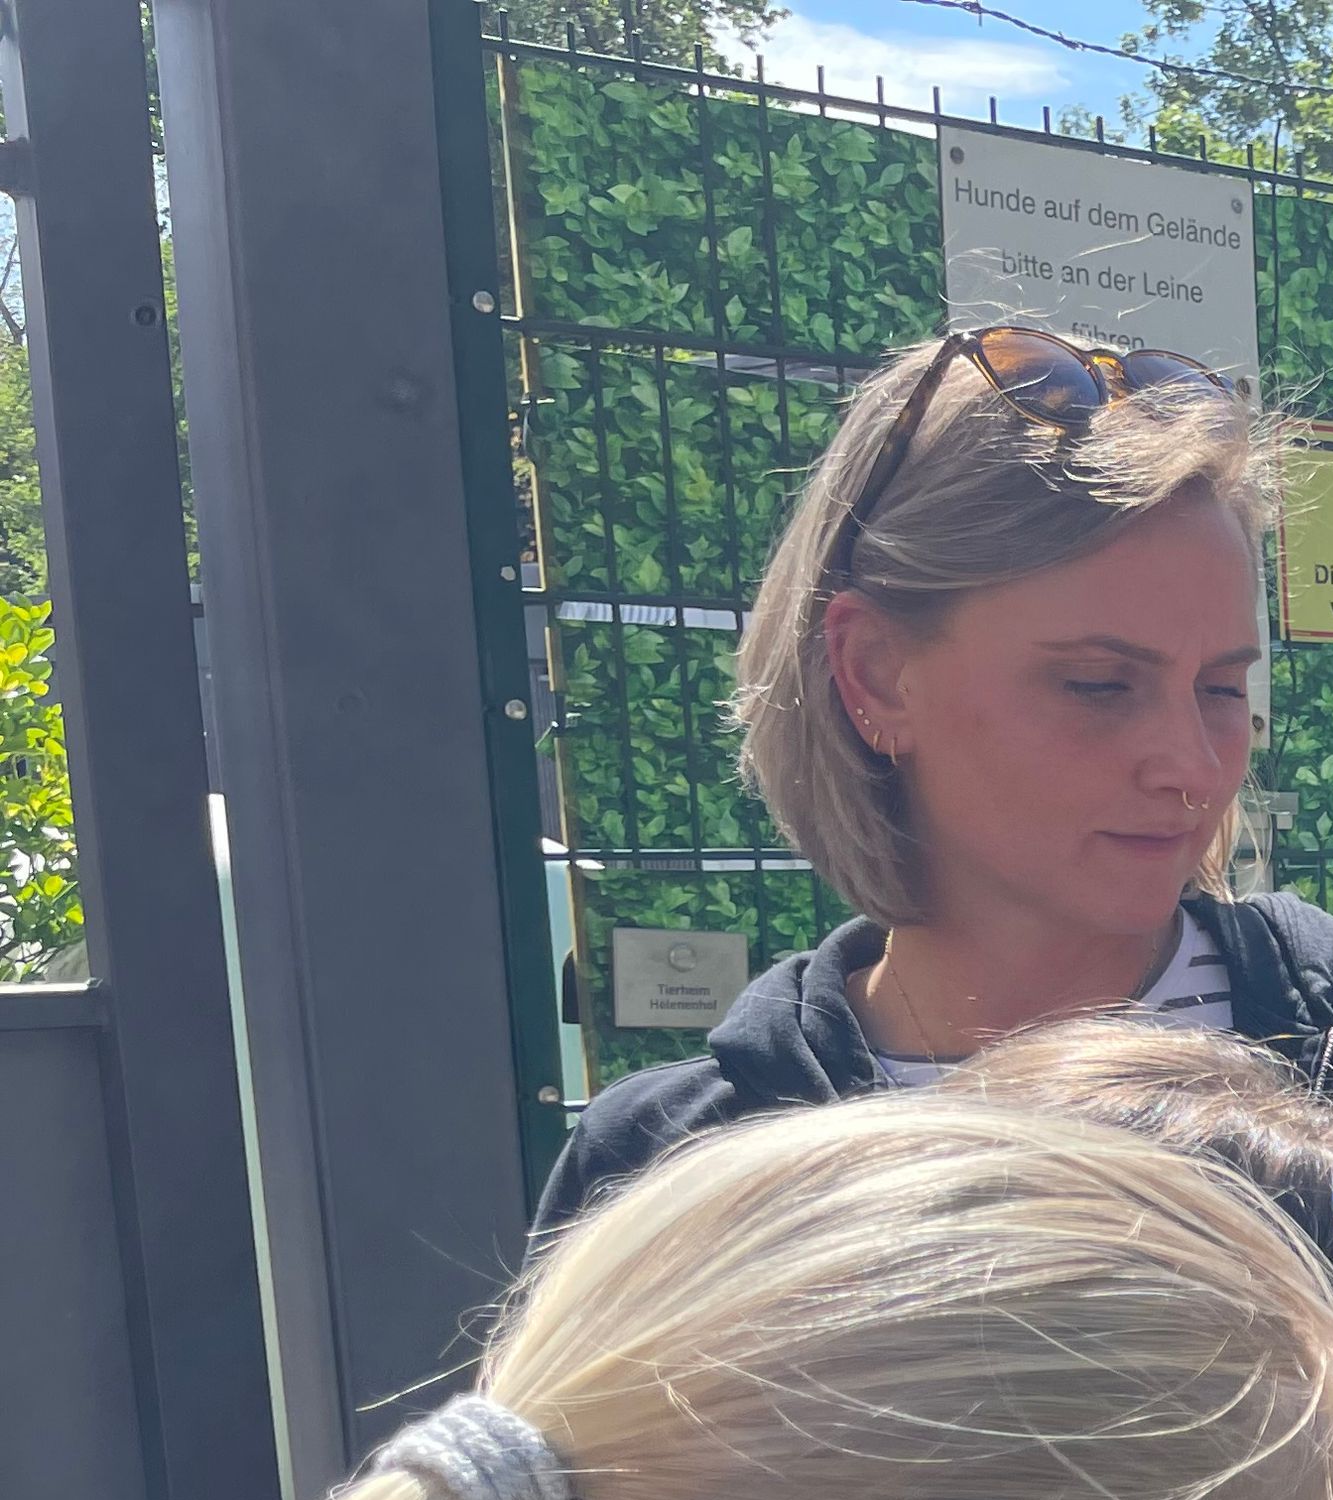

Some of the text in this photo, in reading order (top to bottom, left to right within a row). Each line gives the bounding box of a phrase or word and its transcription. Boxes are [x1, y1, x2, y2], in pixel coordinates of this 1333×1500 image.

[954, 177, 1242, 250] Hunde auf dem Gelände
[1002, 248, 1205, 304] bitte an der Leine
[658, 983, 711, 996] Tierheim
